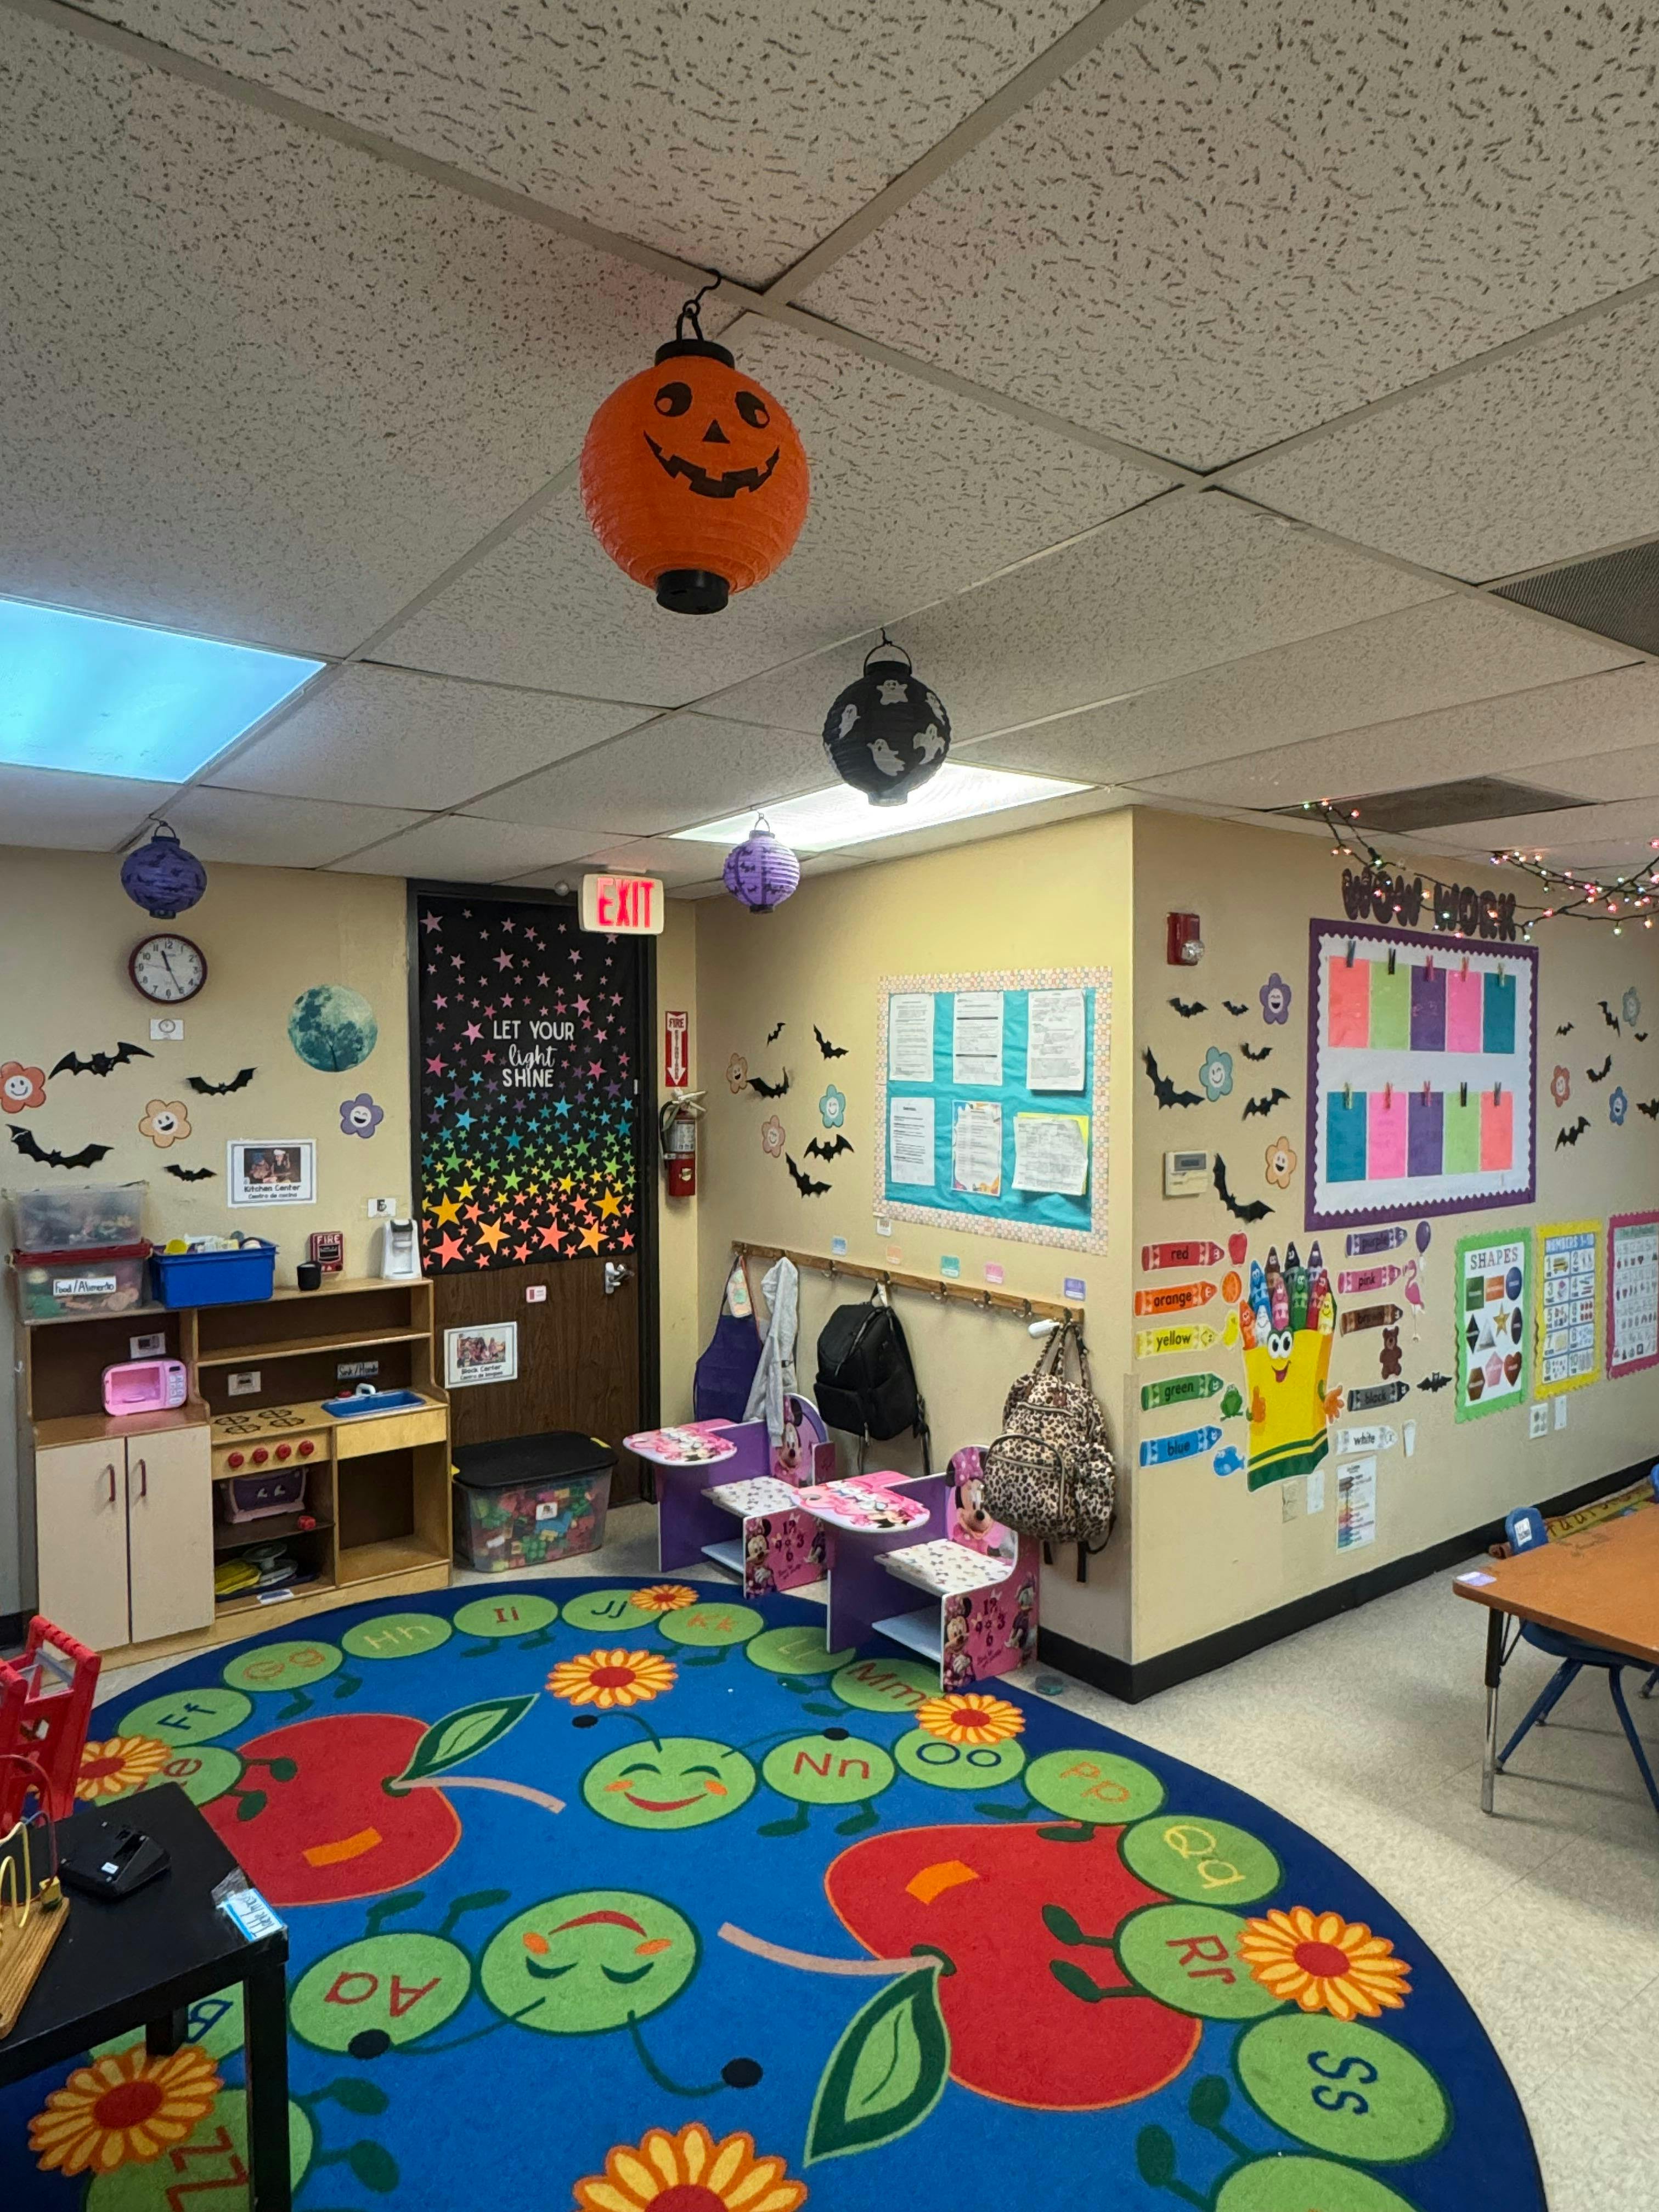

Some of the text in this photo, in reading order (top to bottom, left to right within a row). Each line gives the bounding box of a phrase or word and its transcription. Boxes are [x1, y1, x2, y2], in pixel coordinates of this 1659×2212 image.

[597, 878, 654, 928] EXIT
[1342, 866, 1422, 927] WOW
[165, 940, 173, 949] 12
[180, 945, 184, 953] 1
[139, 963, 144, 972] 9
[189, 955, 194, 963] 2
[143, 975, 148, 984] 8
[494, 1020, 574, 1040] LET YOUR
[669, 1018, 684, 1028] FIRE
[509, 1043, 558, 1070] light
[503, 1068, 554, 1087] SHINE
[317, 1235, 340, 1244] FIRE
[1171, 1245, 1189, 1260] red
[1470, 1247, 1518, 1270] SHAPES
[1358, 1272, 1375, 1289] pink
[1154, 1291, 1192, 1307] orange
[1156, 1330, 1191, 1352] yellow
[1164, 1382, 1194, 1402] green
[1353, 1431, 1376, 1446] white
[1167, 1440, 1190, 1457] blue
[783, 1520, 796, 1535] 12
[797, 1534, 804, 1548] 3
[494, 1606, 520, 1623] Ii
[591, 1600, 628, 1618] Jj
[983, 1598, 997, 1616] 12
[687, 1613, 737, 1633] Kk
[998, 1613, 1006, 1630] 3
[363, 1624, 430, 1650] Hh
[847, 1662, 927, 1706] Mm
[157, 1702, 217, 1731] Ff
[916, 1742, 1002, 1768] Oo
[793, 1751, 870, 1779] Nn
[1060, 1762, 1131, 1803] Pp
[1165, 1934, 1237, 1985] Rr
[324, 1971, 442, 2018] Aa
[1307, 2050, 1378, 2115] Ss
